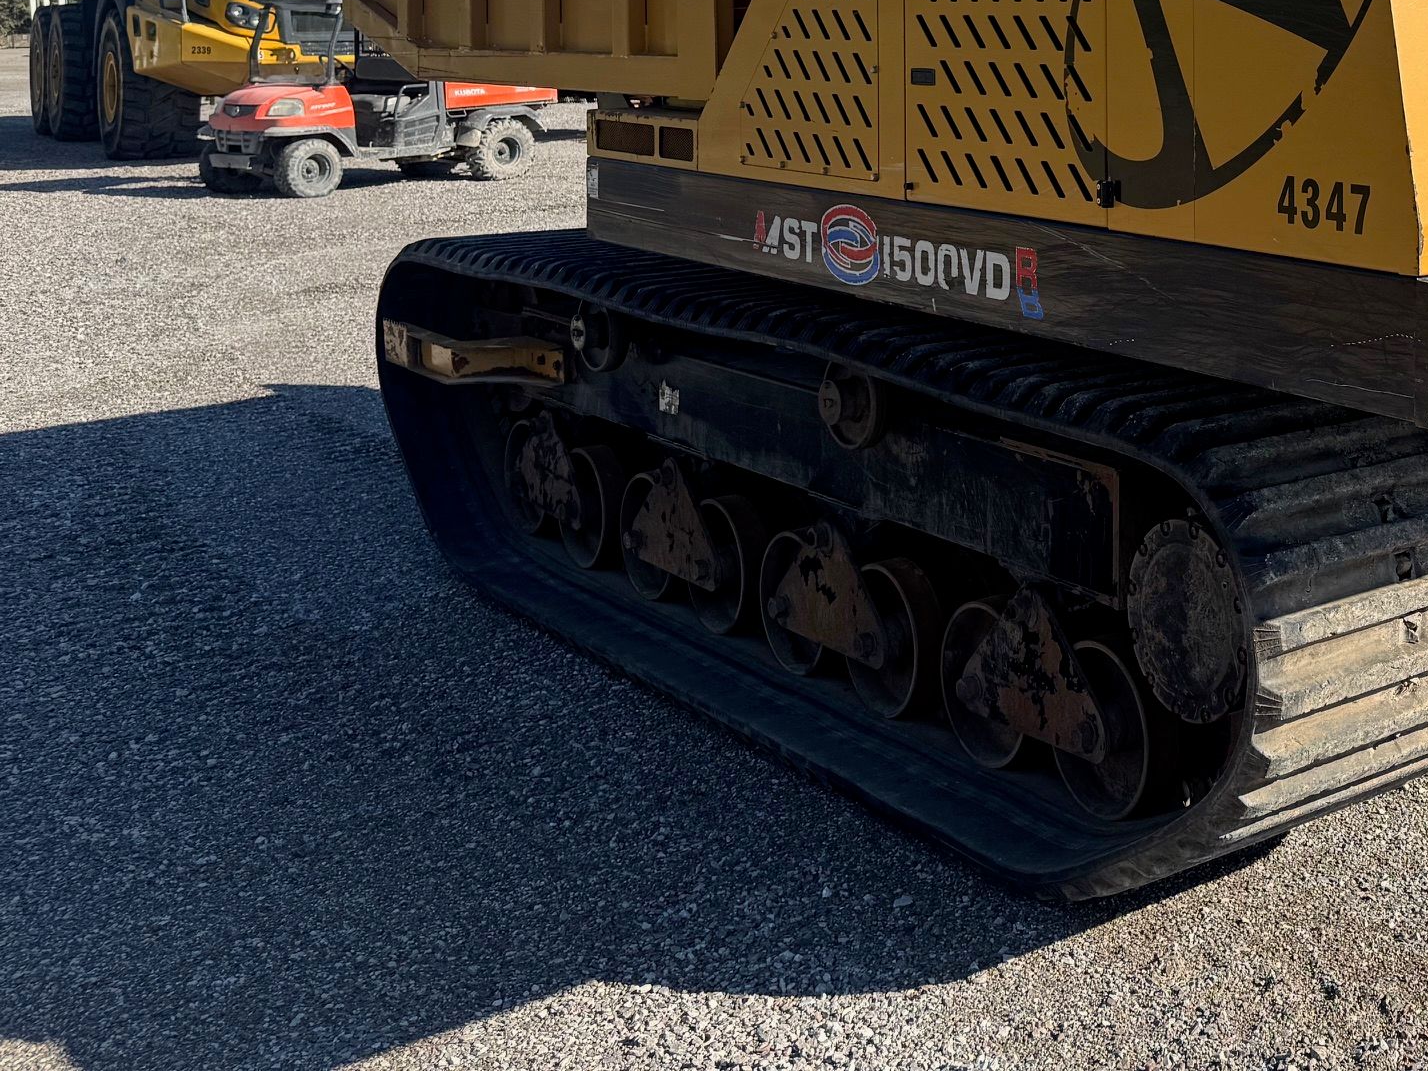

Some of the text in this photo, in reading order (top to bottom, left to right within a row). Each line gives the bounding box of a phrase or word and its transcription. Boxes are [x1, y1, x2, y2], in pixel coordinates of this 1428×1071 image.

[191, 46, 212, 55] 2339
[454, 88, 486, 97] KUBOTA
[1277, 175, 1371, 235] 4347
[753, 209, 818, 263] MST
